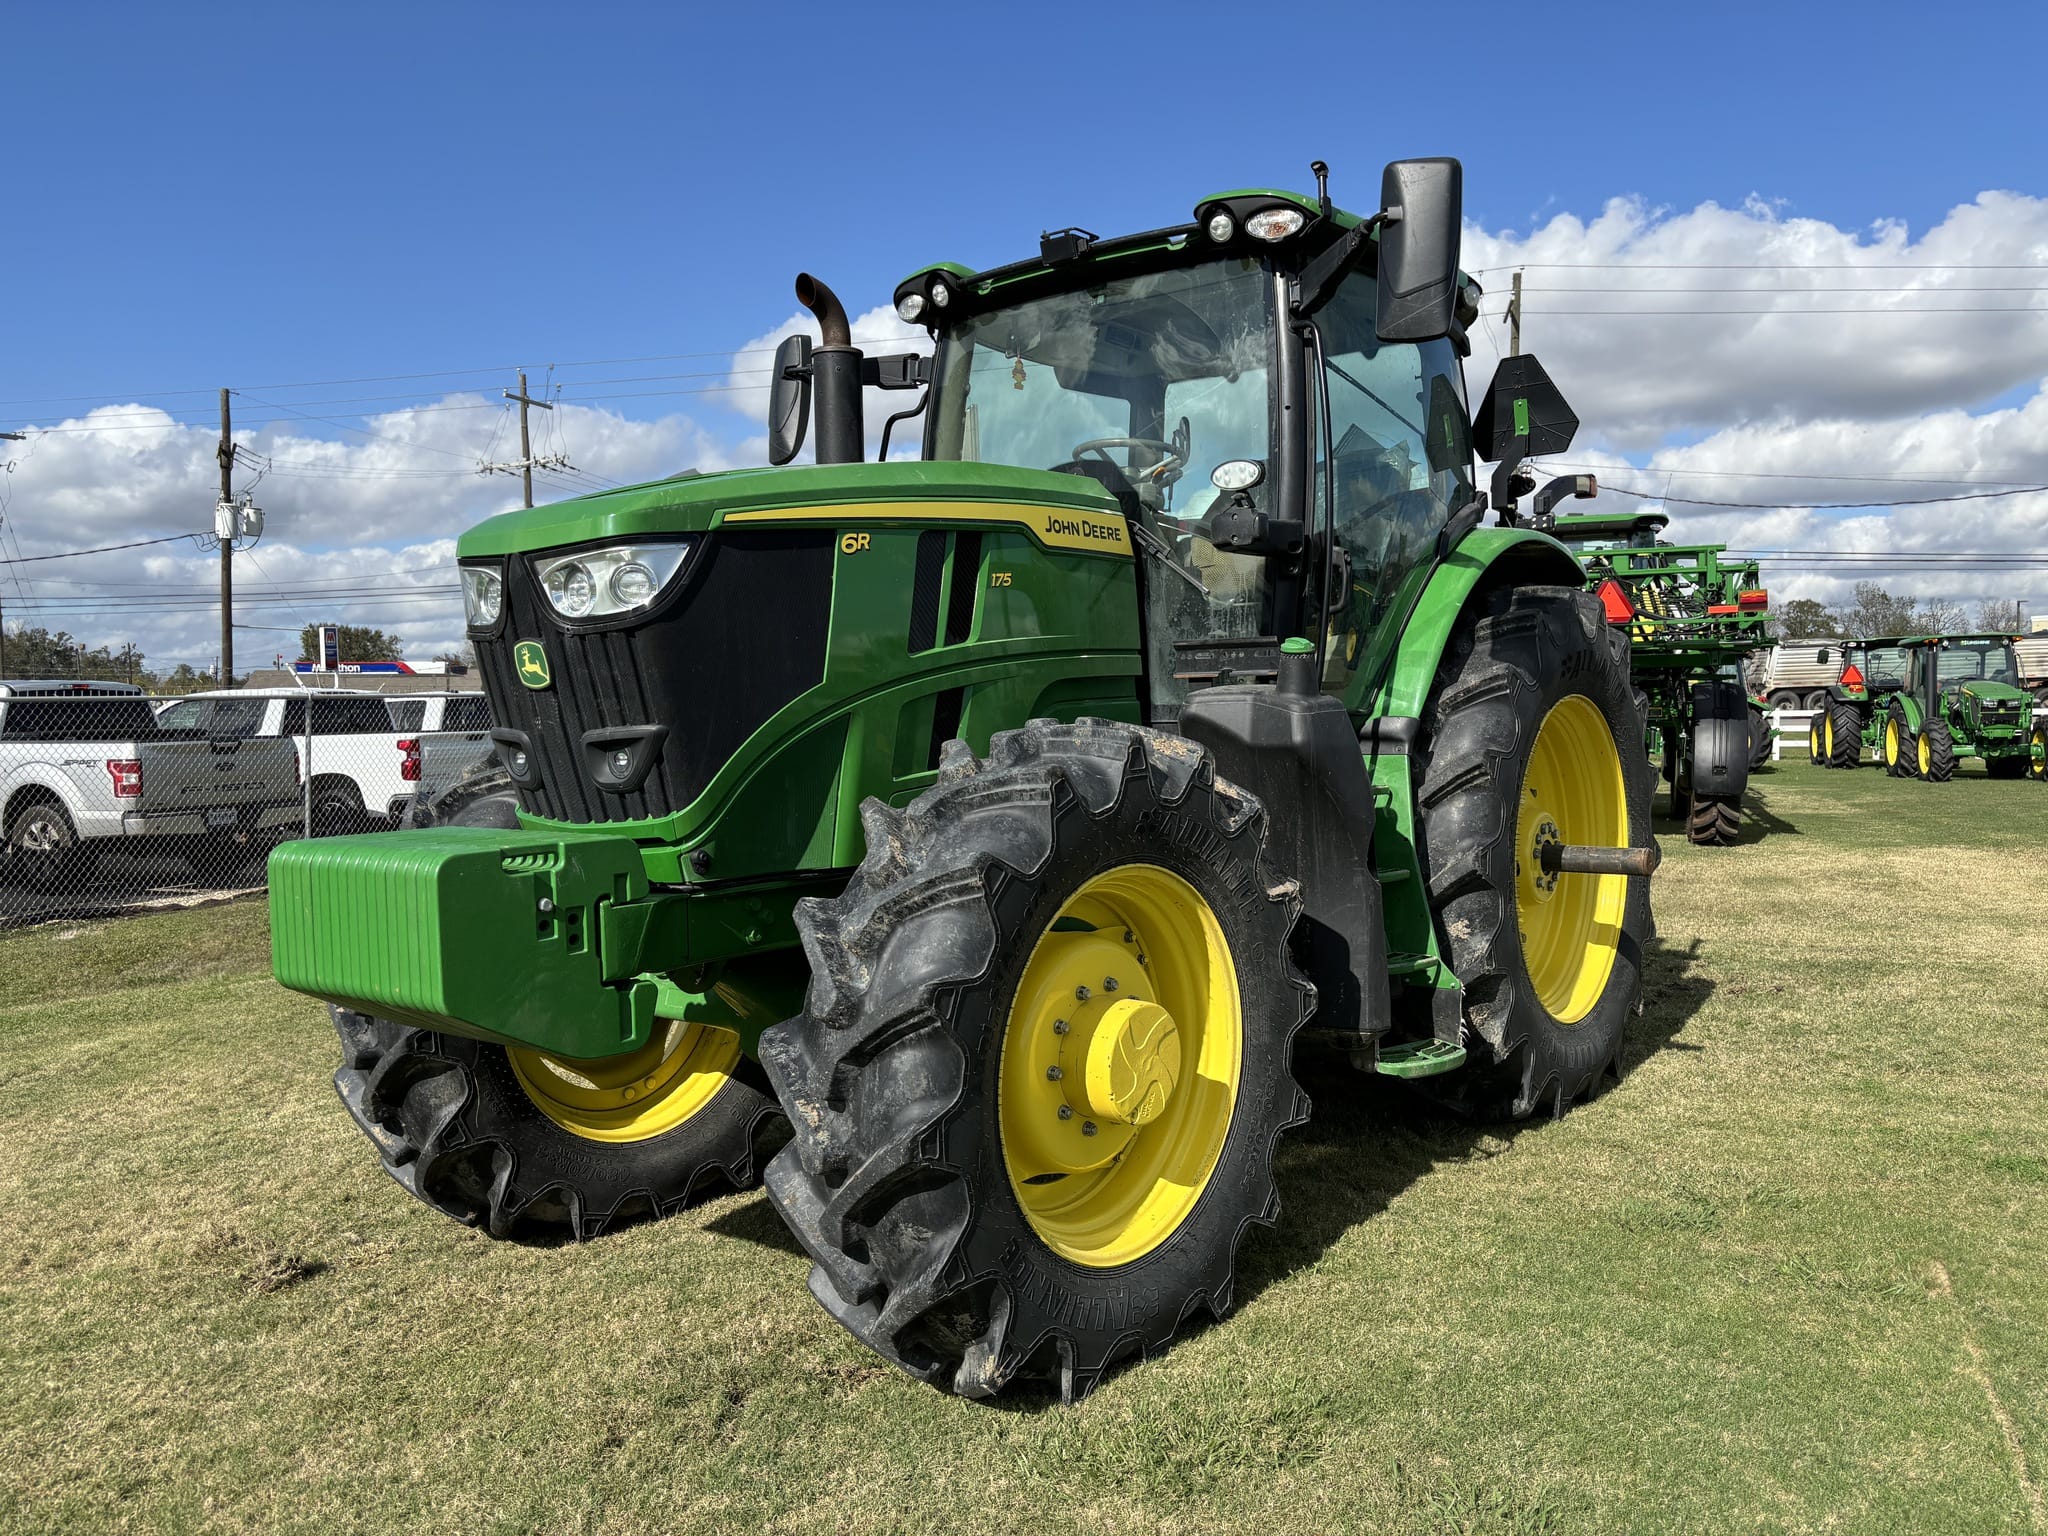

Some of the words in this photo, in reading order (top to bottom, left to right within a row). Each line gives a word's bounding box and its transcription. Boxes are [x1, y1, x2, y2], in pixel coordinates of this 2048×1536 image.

[1045, 515, 1080, 537] JOHN
[1082, 519, 1122, 542] DEERE
[840, 532, 871, 554] 6R
[991, 571, 1013, 588] 175
[312, 663, 361, 673] Mthon
[61, 759, 99, 767] SPORT
[1159, 810, 1264, 922] ALLIANCE
[1000, 1235, 1131, 1331] ALLIANCE
